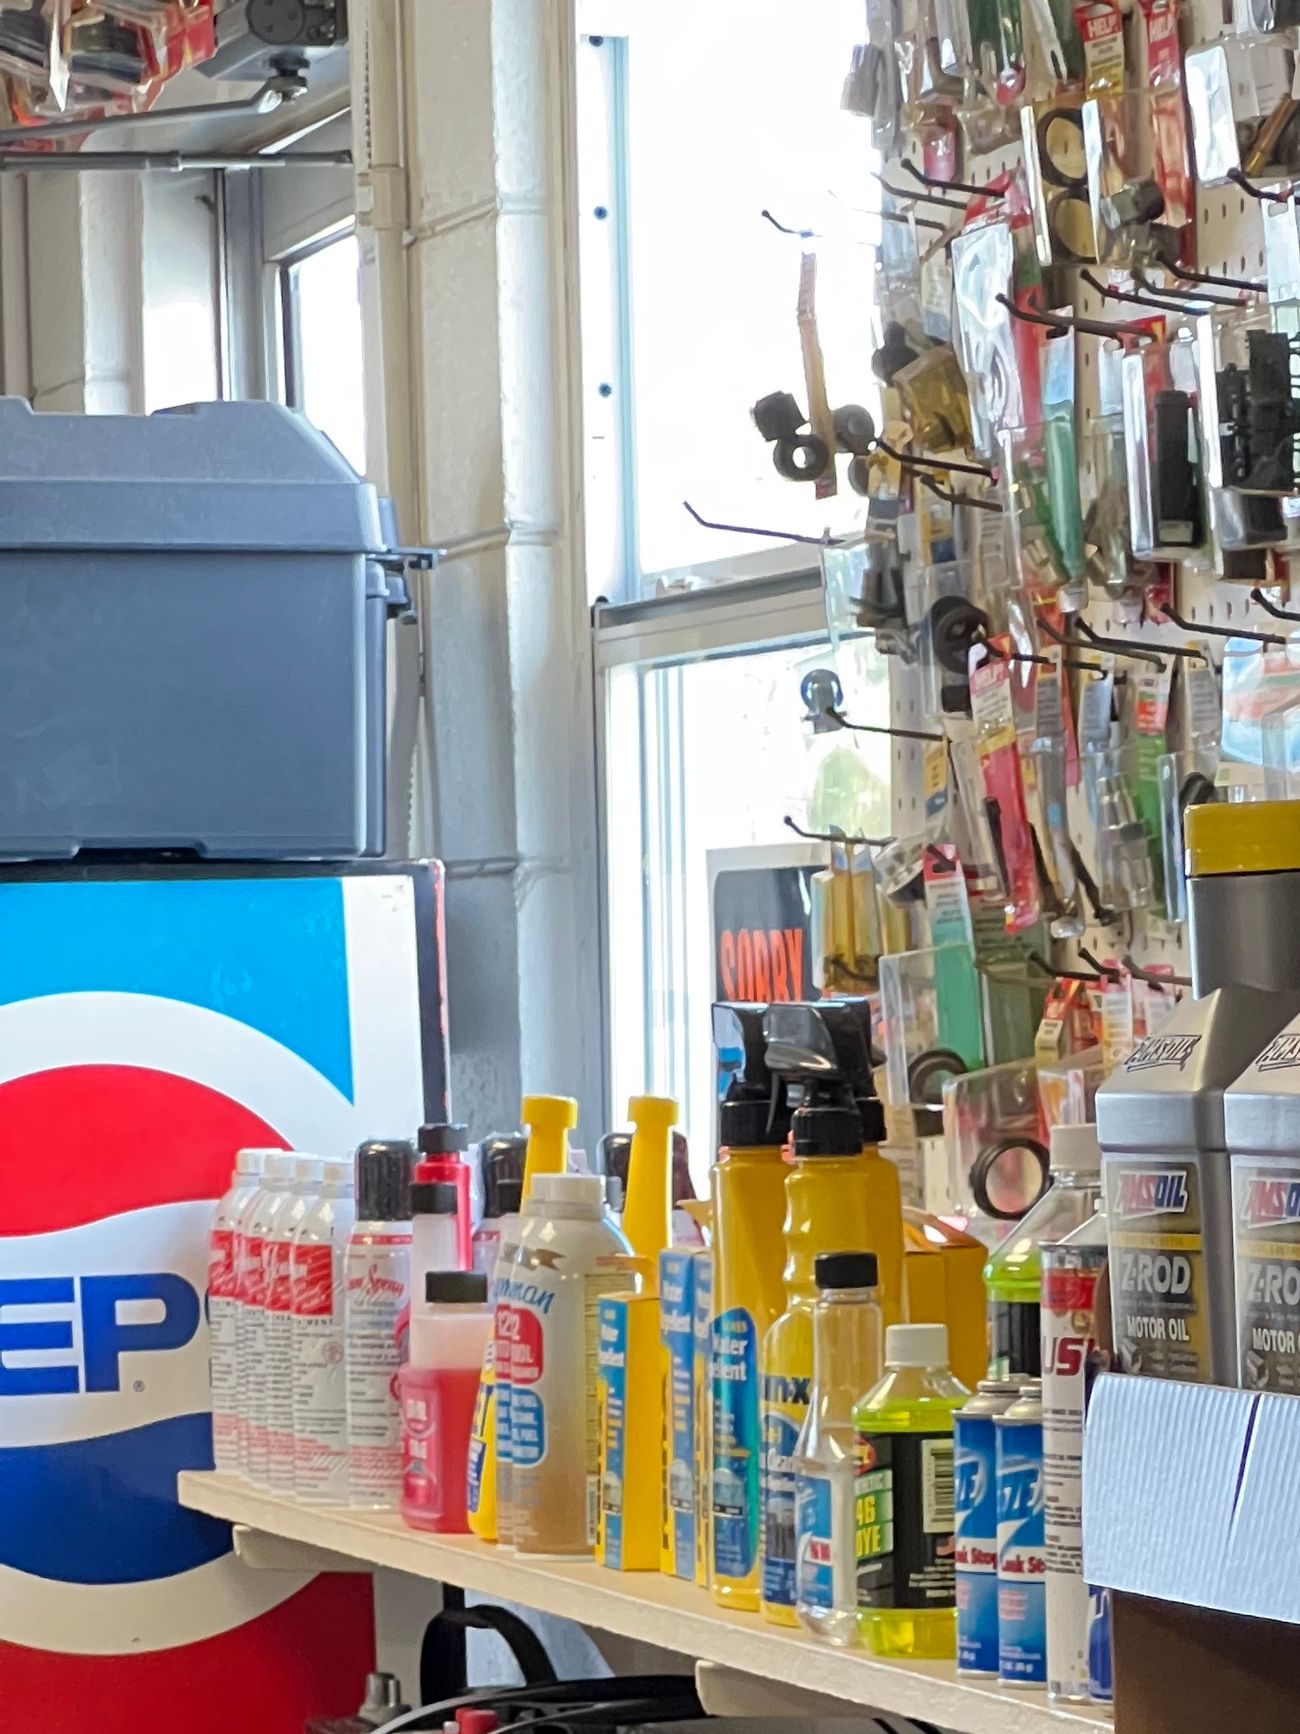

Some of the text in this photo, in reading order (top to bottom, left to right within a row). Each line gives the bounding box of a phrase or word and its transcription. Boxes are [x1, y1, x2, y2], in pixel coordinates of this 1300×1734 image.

[1125, 1034, 1201, 1072] AMSOIL
[1113, 1171, 1188, 1219] AMSOIL
[0, 1272, 213, 1396] EP
[1127, 1315, 1190, 1341] MOTOR OIL
[1252, 1328, 1293, 1352] MOTOR
